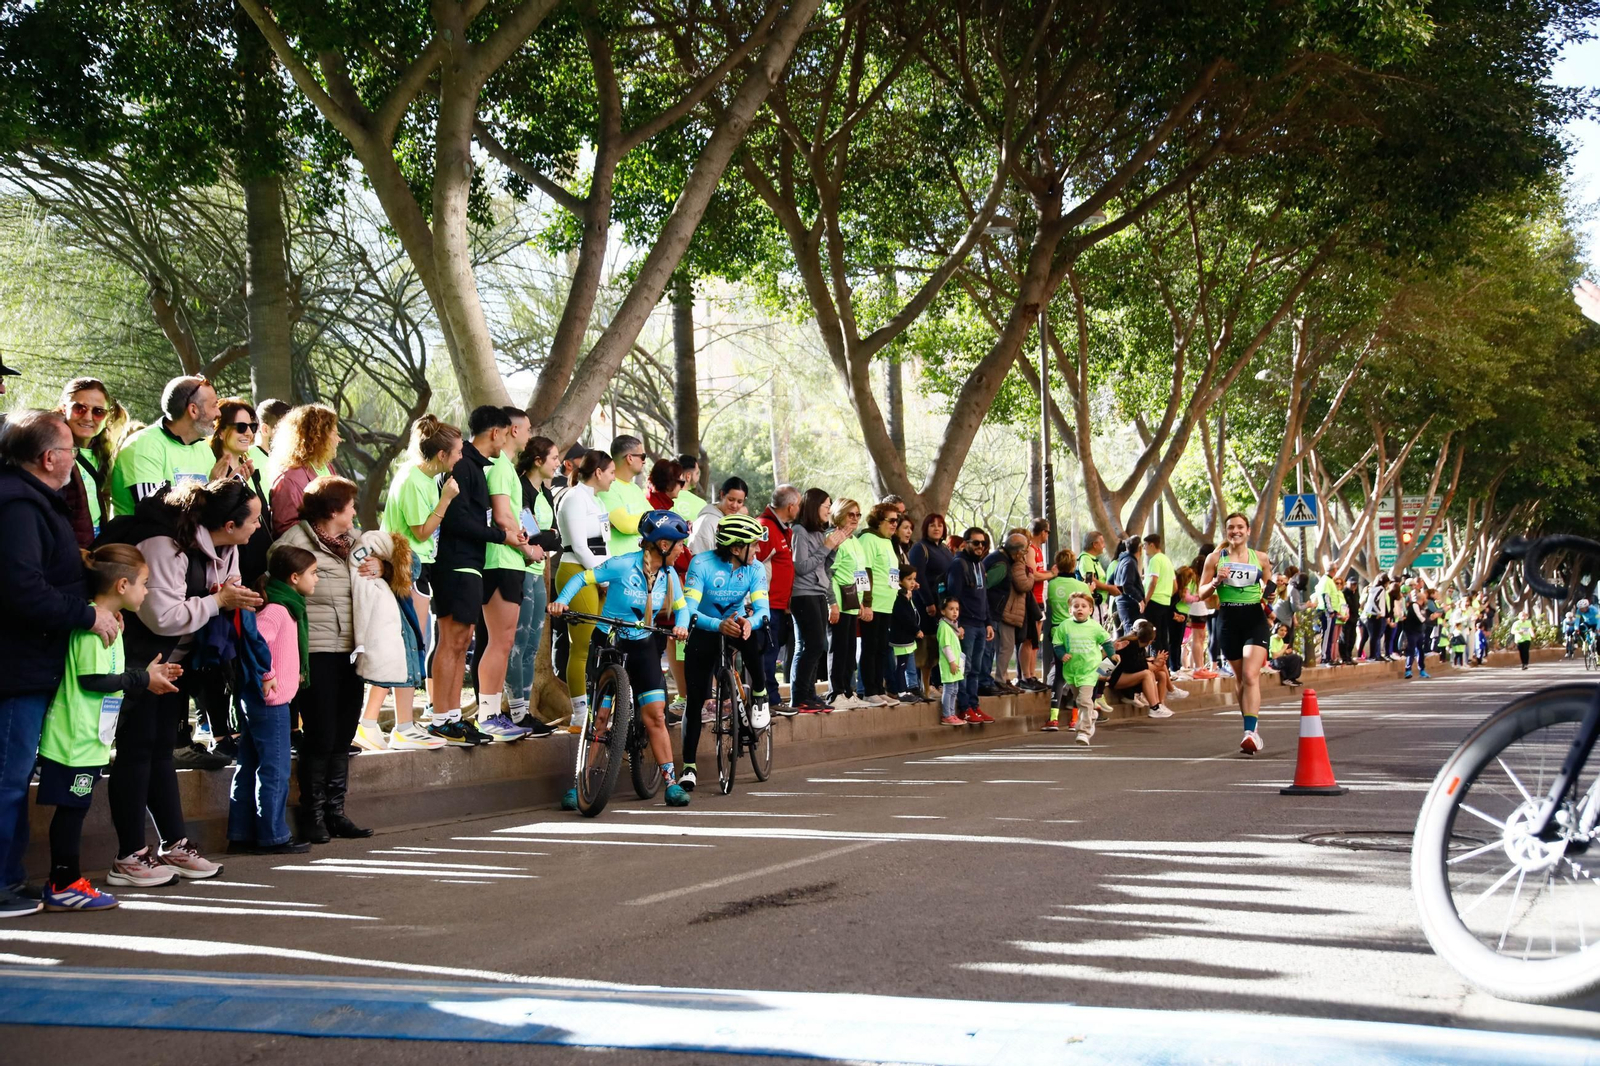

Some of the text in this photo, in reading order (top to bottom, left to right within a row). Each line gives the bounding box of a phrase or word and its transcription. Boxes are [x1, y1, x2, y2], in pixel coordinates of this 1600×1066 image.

[1230, 570, 1250, 579] 731
[623, 587, 665, 600] BIKESTOR
[707, 589, 746, 597] BIKESTOR
